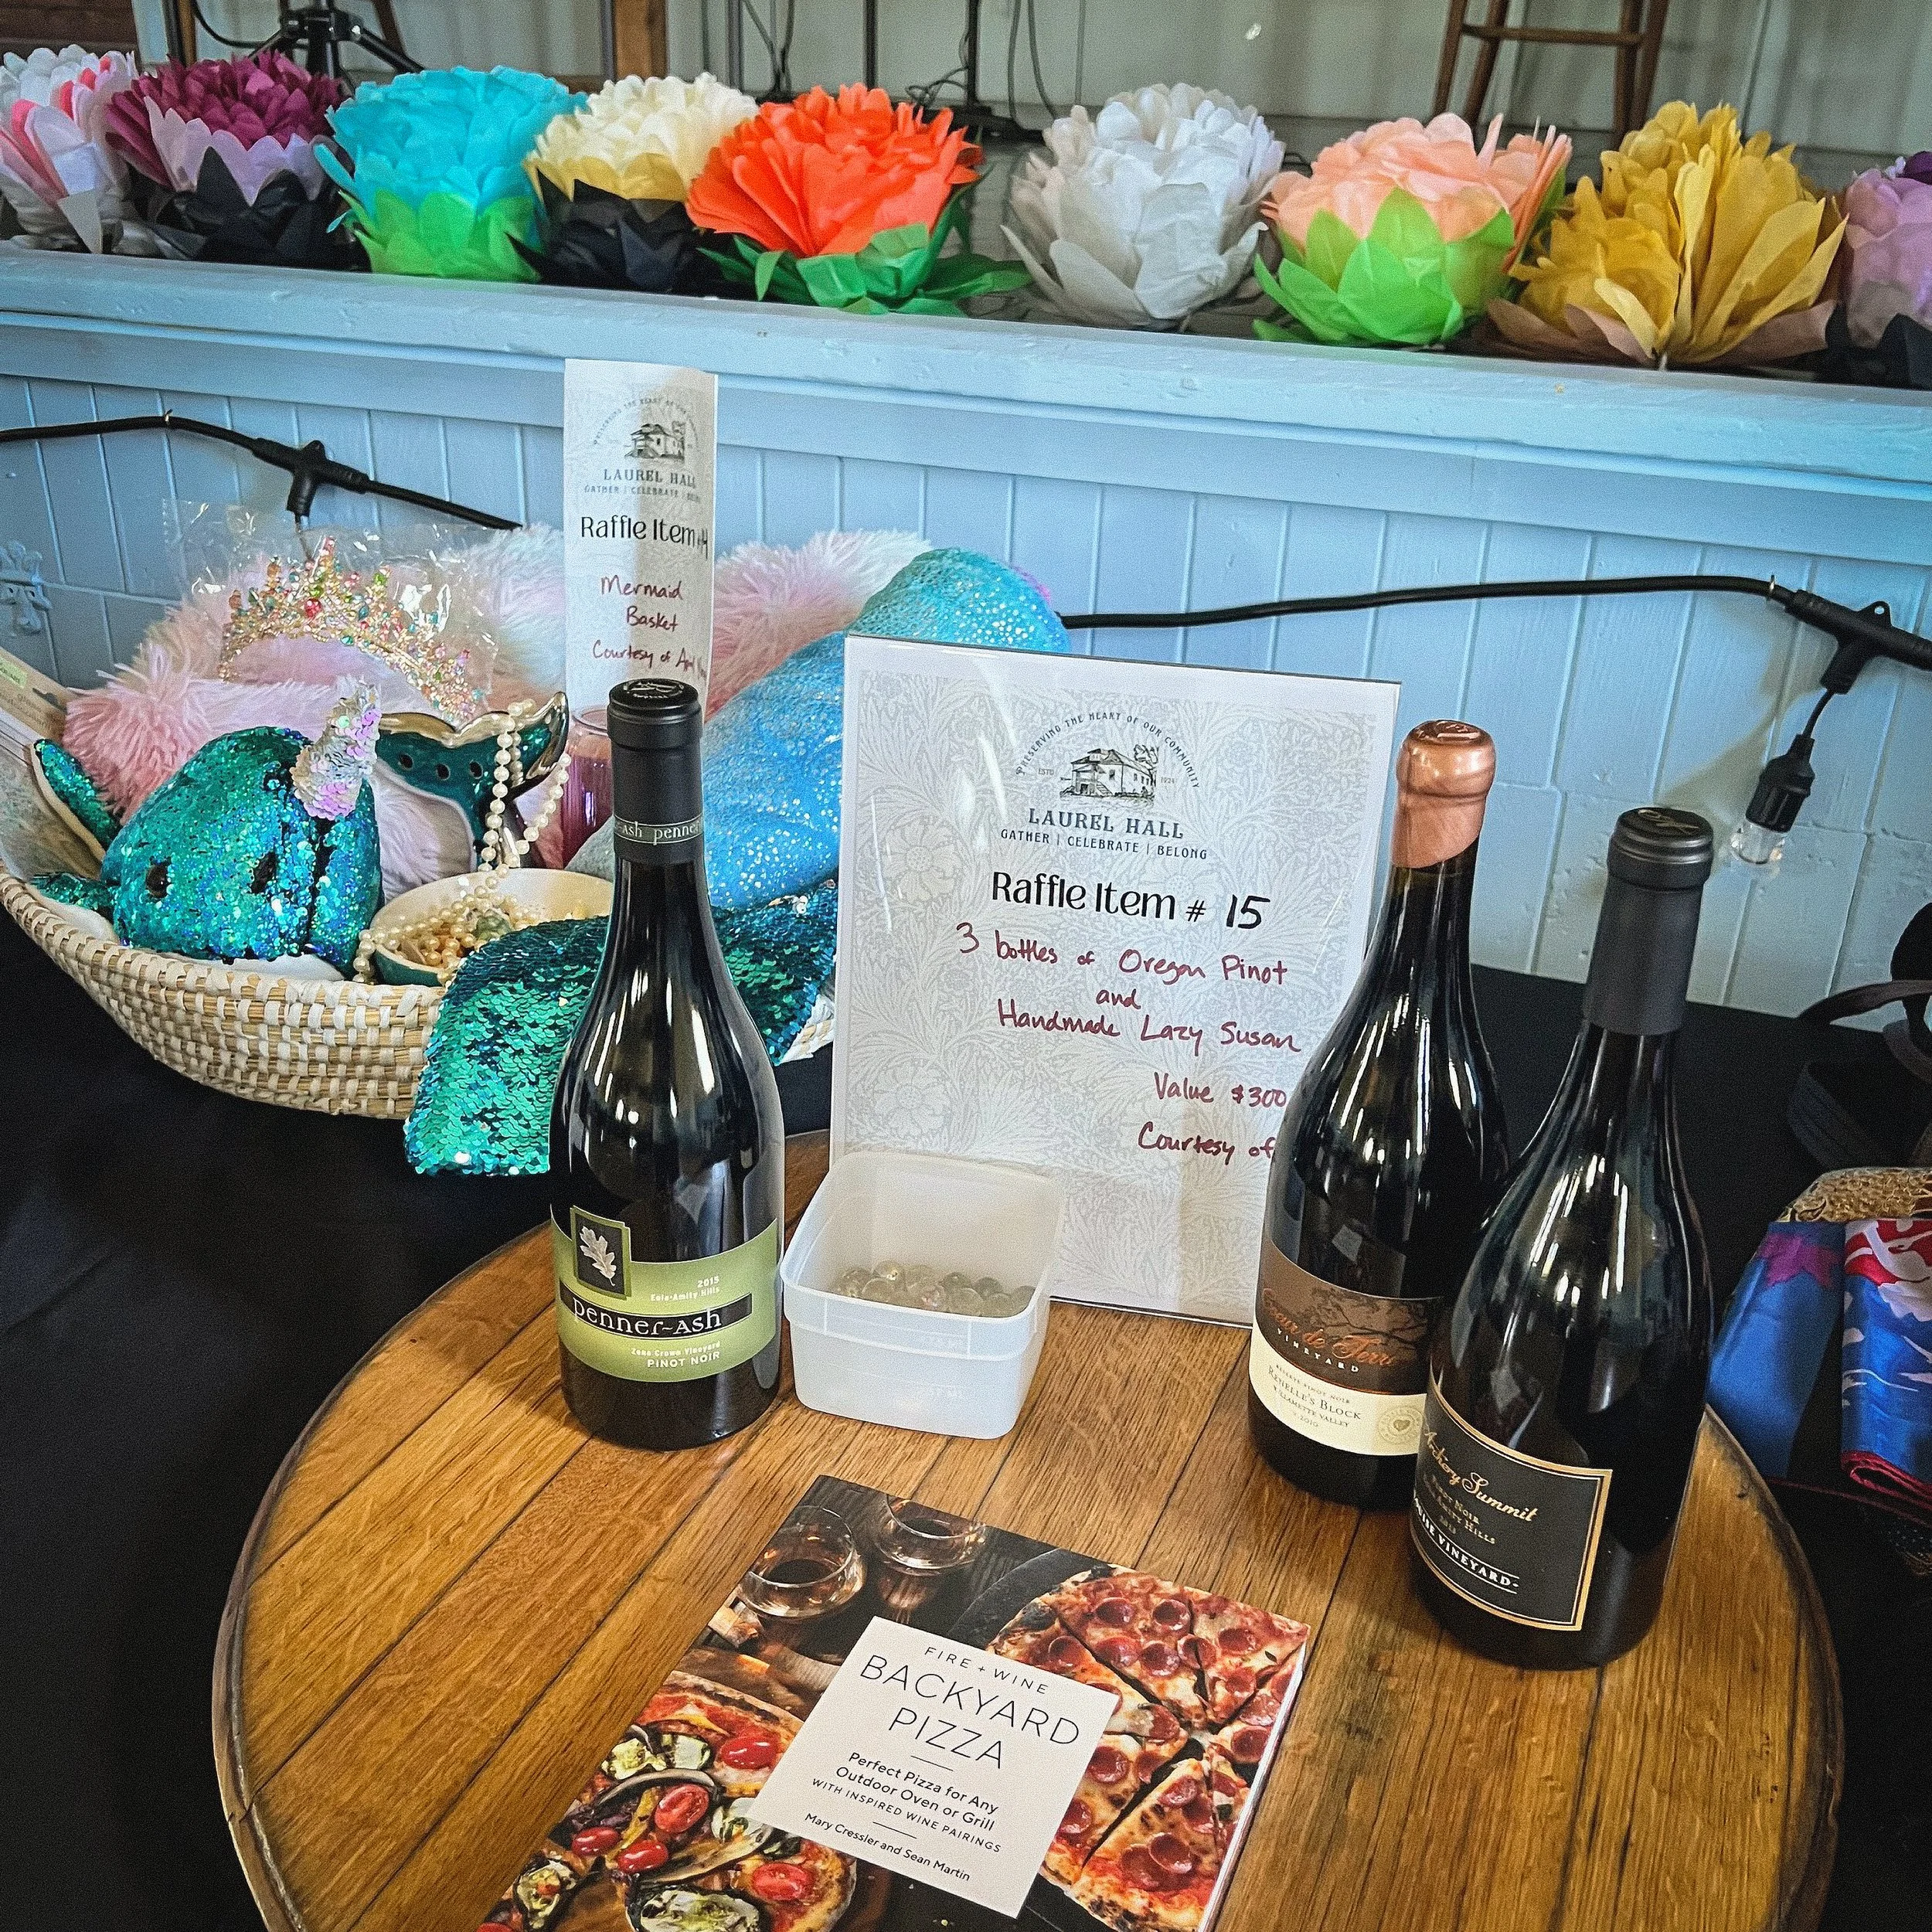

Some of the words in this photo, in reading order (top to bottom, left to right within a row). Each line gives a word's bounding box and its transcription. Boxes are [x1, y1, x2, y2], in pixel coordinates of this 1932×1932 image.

[604, 469, 663, 483] LAUREL
[670, 472, 696, 490] HALL
[581, 515, 647, 540] Raffle
[653, 519, 695, 548] Item
[600, 574, 683, 600] Mermaid
[626, 605, 679, 632] Basket
[593, 639, 653, 668] Courtesy
[660, 651, 672, 662] of
[1015, 724, 1061, 776] PRESERVING
[1065, 716, 1083, 728] THE
[1089, 712, 1121, 722] HEART
[1127, 716, 1139, 724] OF
[1143, 722, 1162, 737] OUR
[1164, 736, 1200, 788] COMMUNITY
[1029, 808, 1114, 833] LAUREL
[1126, 818, 1184, 839] HALL
[1001, 828, 1050, 844] GATHER
[1067, 836, 1139, 853] CELEBRATE
[1157, 845, 1208, 859] BELONG
[992, 871, 1086, 910] Raffle
[1095, 882, 1175, 920] Item
[1185, 900, 1206, 923] #
[1226, 894, 1271, 930] 15
[956, 922, 980, 954] 3
[995, 930, 1058, 965] bottles
[1077, 951, 1095, 965] of
[1118, 949, 1206, 985] Oregon
[1221, 954, 1288, 985] Pinot
[1096, 988, 1141, 1009] and
[998, 998, 1121, 1037] Handmade
[1140, 1015, 1203, 1056] Lazy
[1220, 1021, 1302, 1053] Susan
[1154, 1072, 1214, 1103] Value
[1231, 1084, 1287, 1108] $300
[1138, 1121, 1235, 1165] Courtesy
[1248, 1136, 1275, 1158] of
[697, 1276, 719, 1287] 2015
[700, 1286, 719, 1296] Hills
[647, 1358, 685, 1368] PINOT
[690, 1351, 720, 1365] NOIR
[685, 1341, 720, 1355] Vineyard
[1277, 1328, 1359, 1372] VINEYARD
[1319, 1413, 1349, 1427] VALLEY
[1320, 1400, 1361, 1420] BLOCK
[1454, 1499, 1480, 1525] NOIR
[1462, 1472, 1538, 1522] Summit
[1464, 1519, 1495, 1544] HILLS
[1438, 1533, 1511, 1586] VINEYARD
[924, 1646, 971, 1669] FIRE
[994, 1668, 1049, 1695] WINE
[860, 1655, 1080, 1744] BACKYARD
[889, 1707, 1002, 1770] PIZZA
[836, 1766, 898, 1796] Outdoor
[900, 1789, 939, 1811] Oven
[942, 1806, 960, 1818] or
[962, 1811, 995, 1832] Grill
[849, 1752, 902, 1779] Perfect
[903, 1771, 942, 1793] Pizza
[945, 1786, 968, 1801] for
[968, 1795, 999, 1815] Any
[812, 1778, 843, 1795] WITH
[845, 1790, 903, 1815] INSPIRED
[906, 1811, 939, 1830] WINE
[941, 1825, 1002, 1852] PAIRINGS
[804, 1813, 833, 1831] Mary
[835, 1823, 880, 1846] Cressler
[880, 1842, 903, 1855] and
[903, 1849, 931, 1866] Sean
[933, 1859, 971, 1882] Martin
